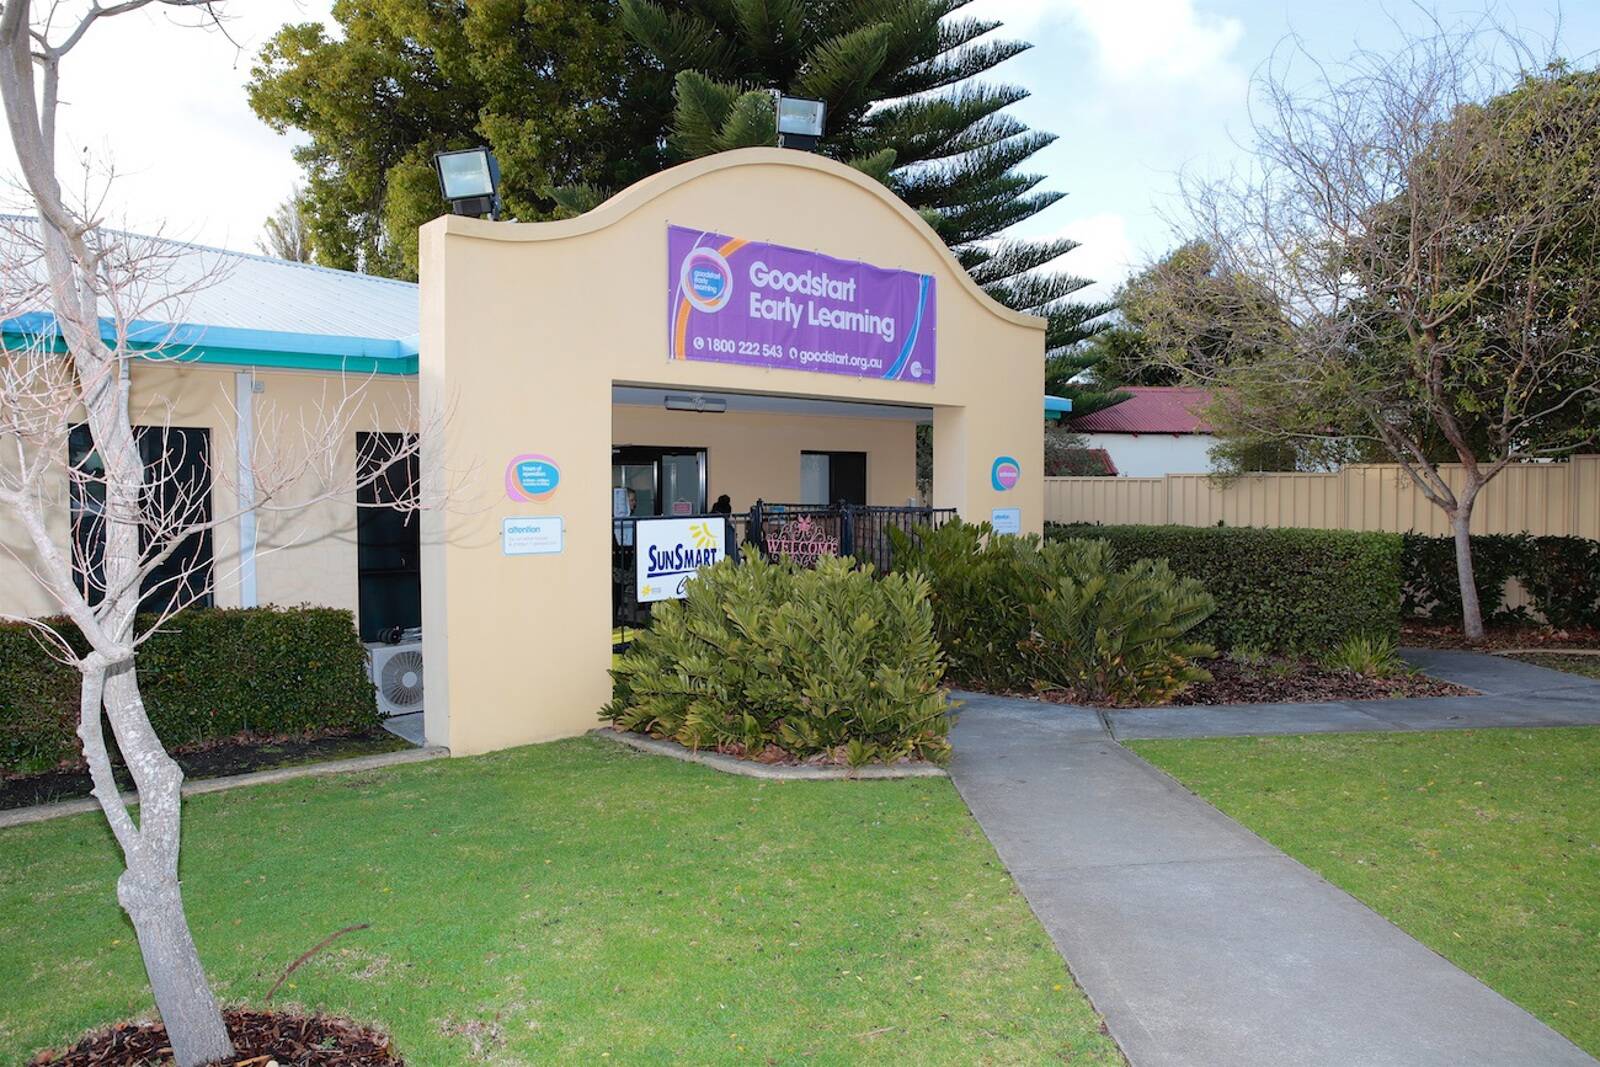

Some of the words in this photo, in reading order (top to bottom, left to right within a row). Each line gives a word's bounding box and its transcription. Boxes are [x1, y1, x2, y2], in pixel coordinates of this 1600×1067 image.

[749, 261, 856, 302] Goodstart
[749, 292, 804, 329] Early
[808, 301, 896, 343] Learning
[707, 337, 736, 354] 1800
[738, 340, 761, 356] 222
[762, 343, 783, 359] 543
[800, 350, 883, 371] goodstart.org.au
[507, 526, 541, 534] attention
